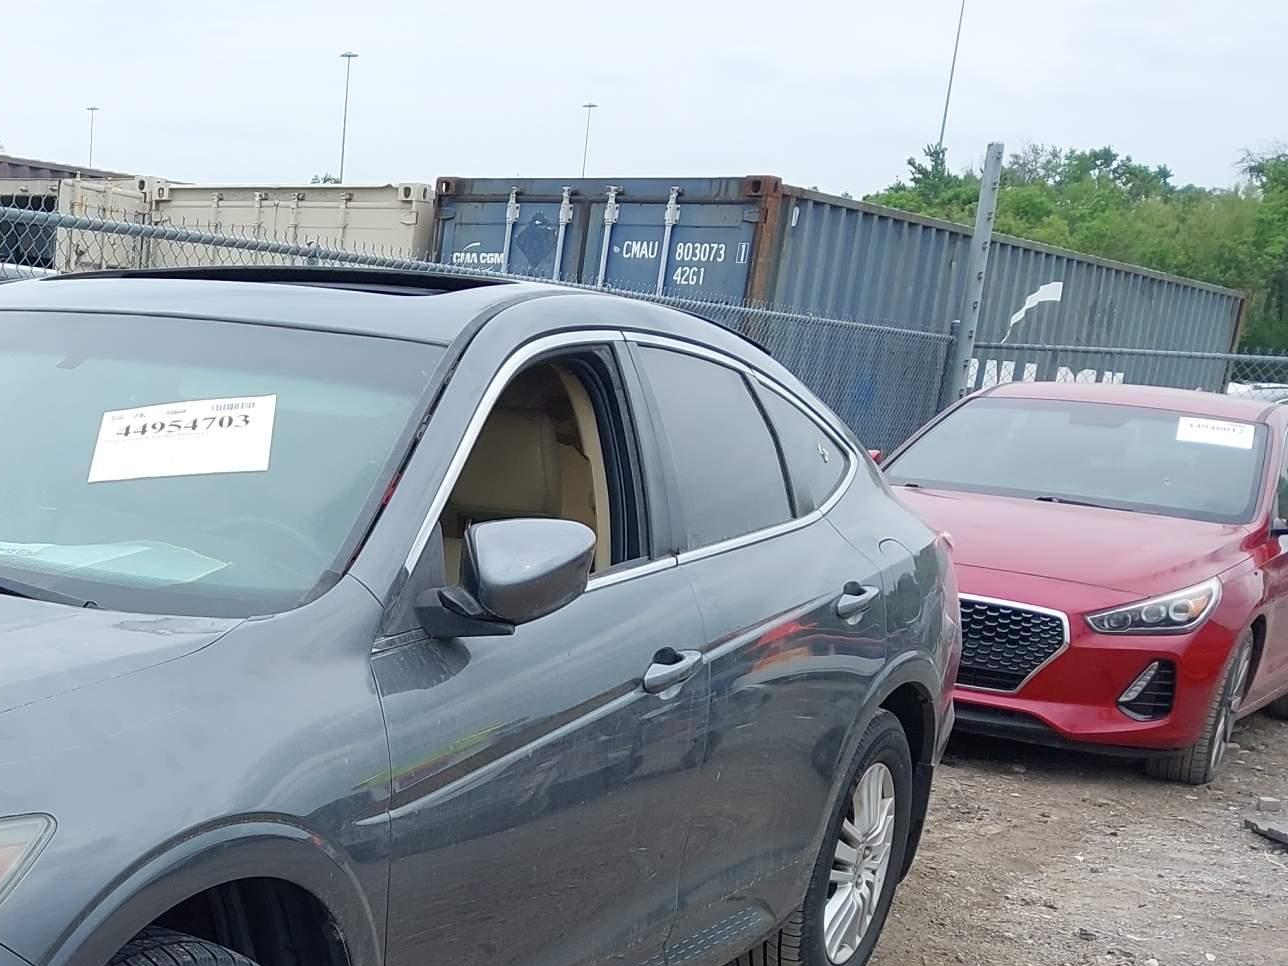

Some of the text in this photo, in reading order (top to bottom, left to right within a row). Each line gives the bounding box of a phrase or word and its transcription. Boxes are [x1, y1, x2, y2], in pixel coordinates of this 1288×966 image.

[453, 252, 505, 265] CMA CGM
[623, 241, 658, 259] CMAU
[675, 242, 726, 262] 803073
[673, 266, 705, 285] 42G1
[116, 414, 250, 437] 44954703
